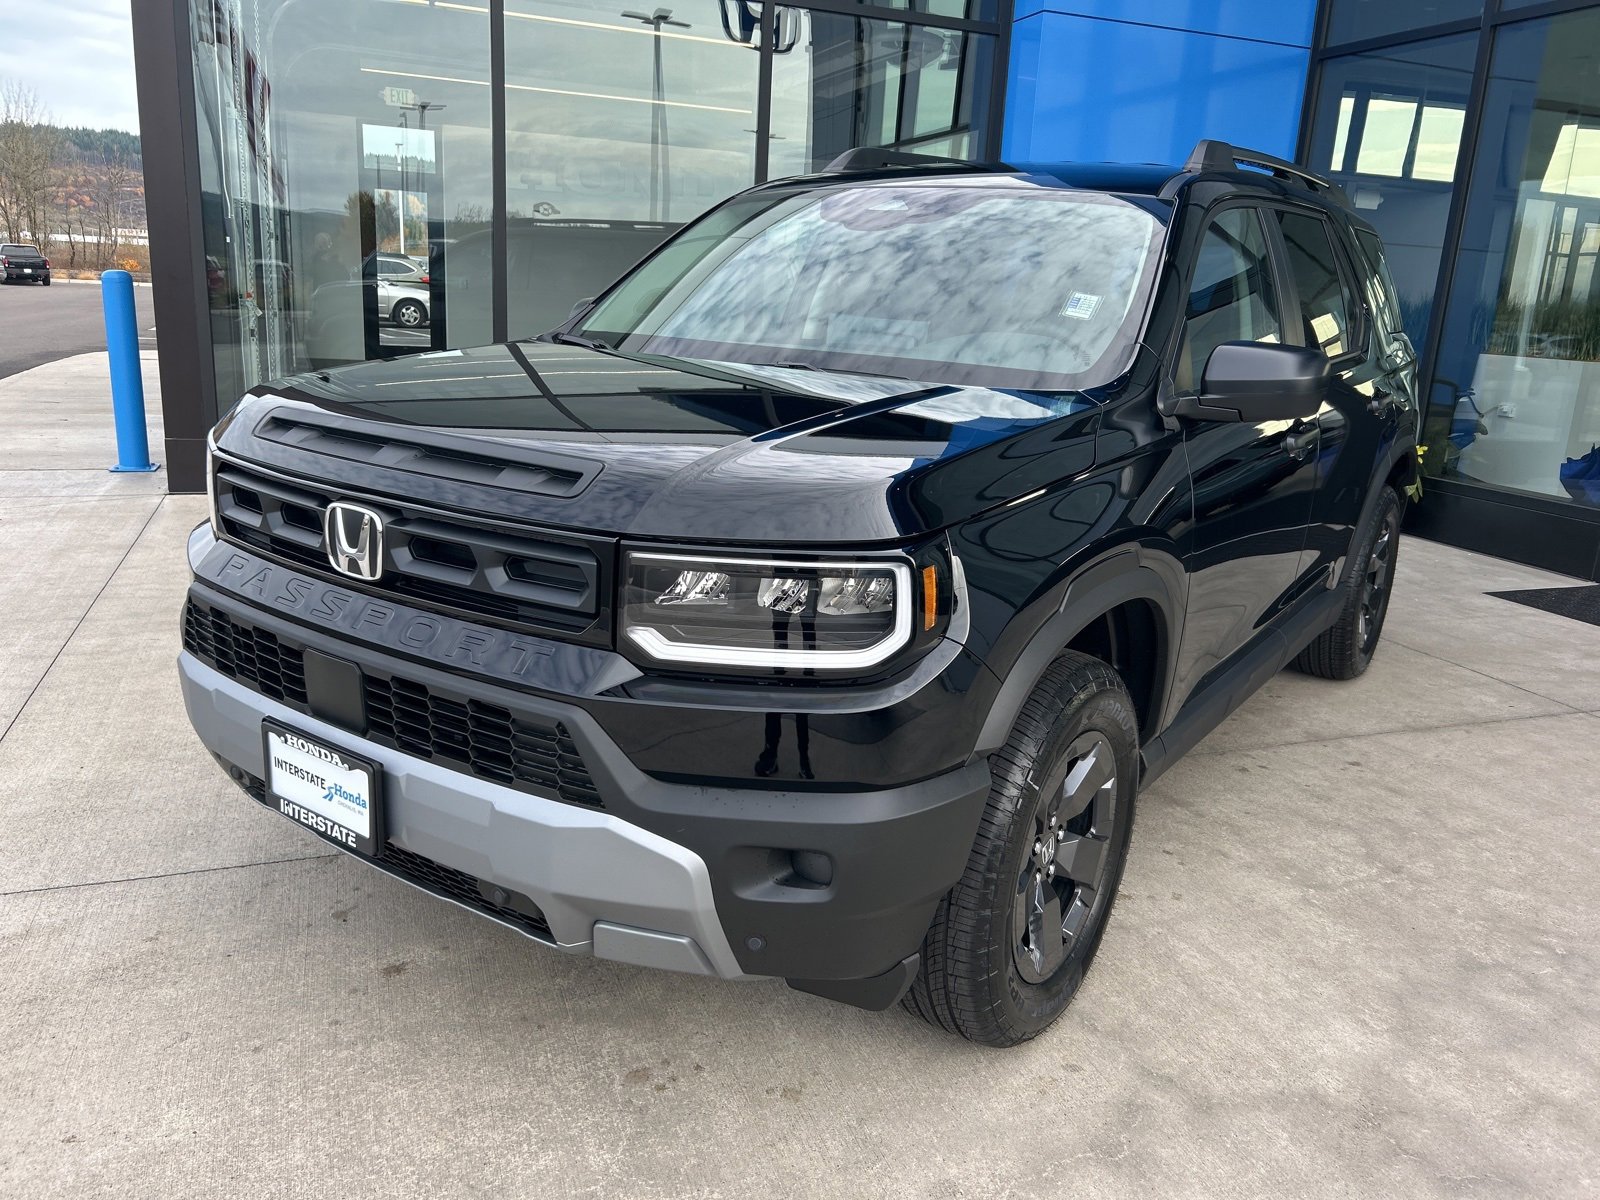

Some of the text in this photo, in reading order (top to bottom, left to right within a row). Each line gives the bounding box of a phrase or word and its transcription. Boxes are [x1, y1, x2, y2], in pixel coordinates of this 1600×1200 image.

[390, 88, 409, 104] EXIT
[216, 553, 556, 675] PASSPORT
[286, 733, 342, 768] HONDA
[274, 757, 367, 808] INTERSTATE Honda
[280, 798, 357, 848] INTERSTATE
